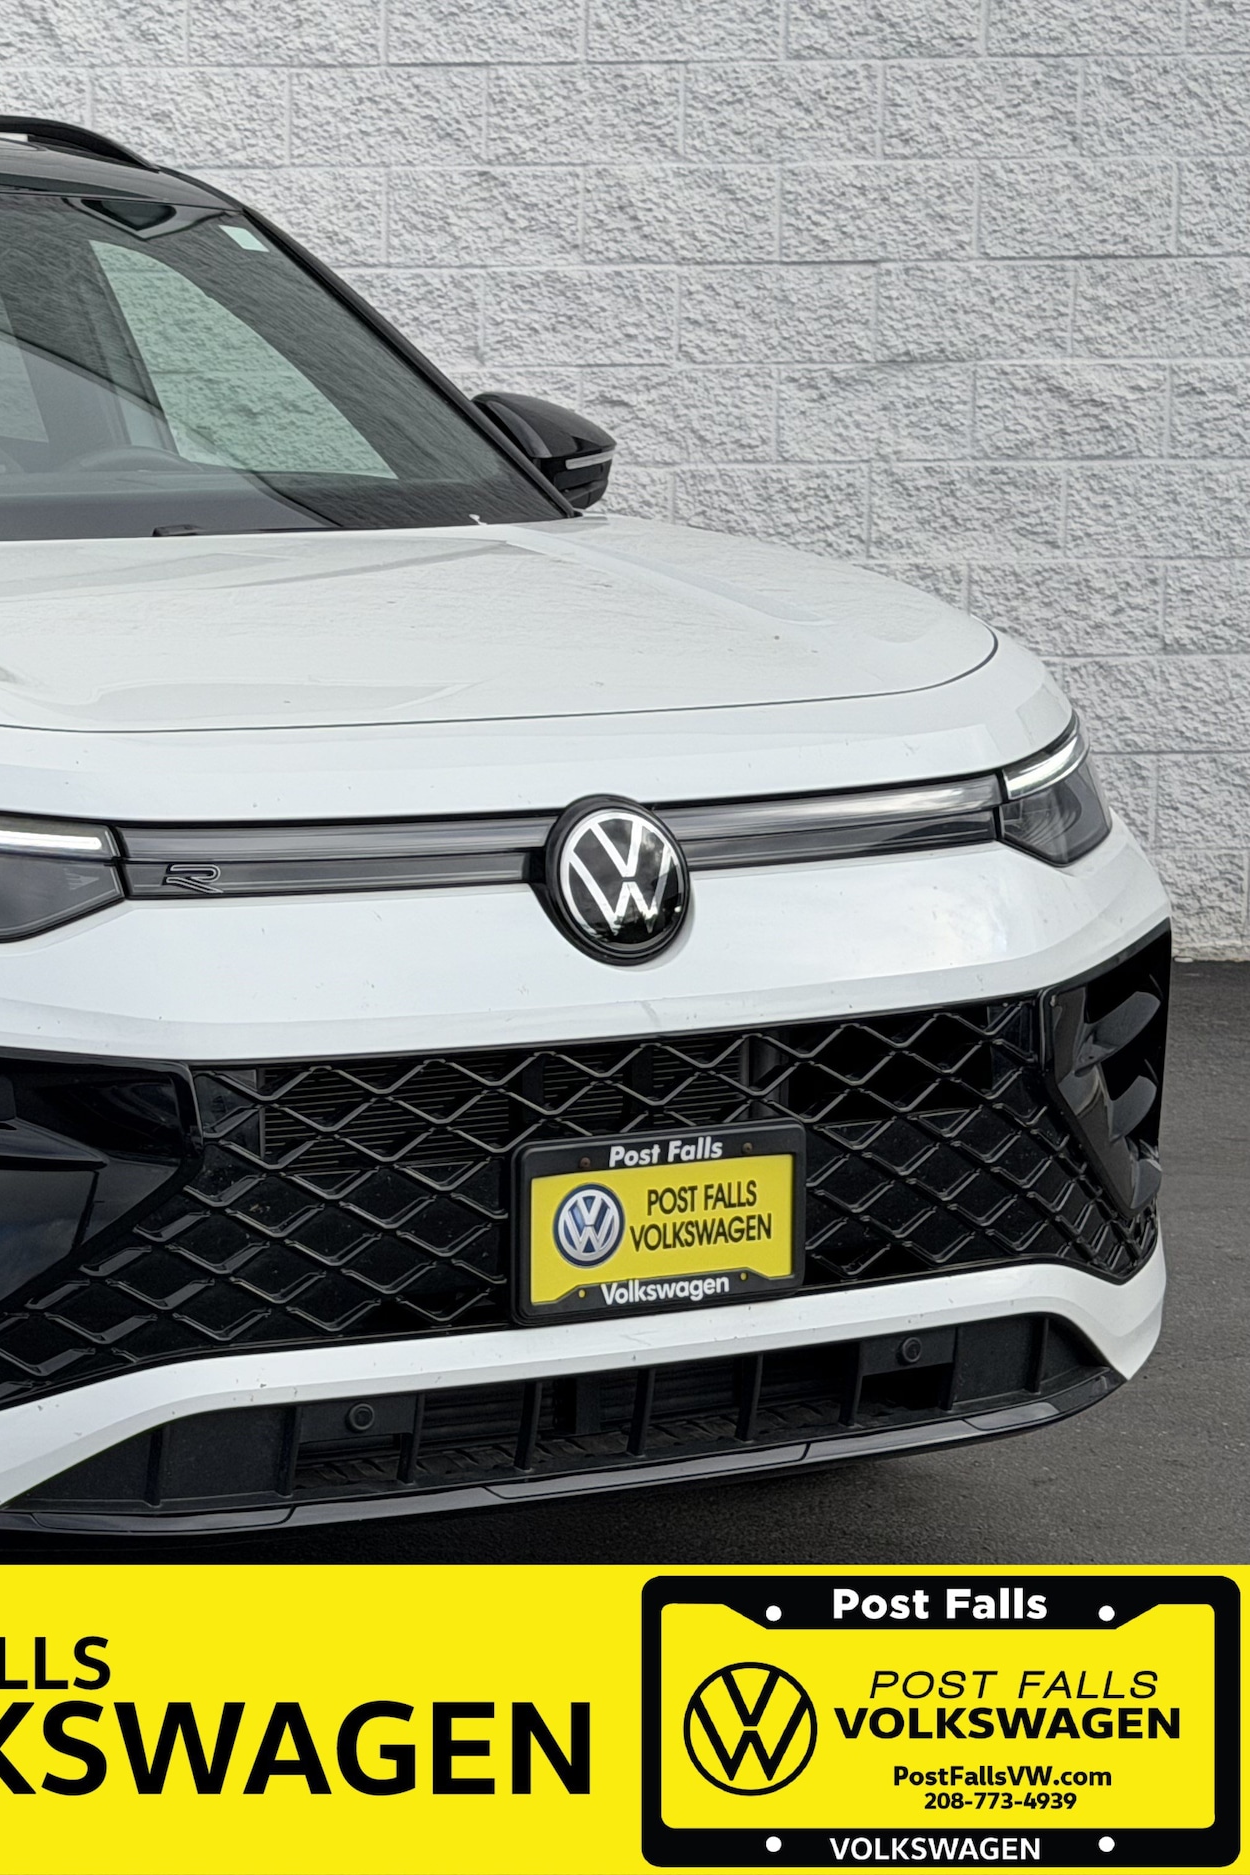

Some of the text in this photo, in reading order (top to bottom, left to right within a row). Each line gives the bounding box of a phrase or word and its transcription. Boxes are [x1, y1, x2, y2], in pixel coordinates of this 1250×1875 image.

[608, 1136, 723, 1168] Post Falls
[647, 1180, 758, 1216] POST FALLS
[629, 1213, 772, 1252] VOLKSWAGEN
[600, 1276, 730, 1306] Volkswagen
